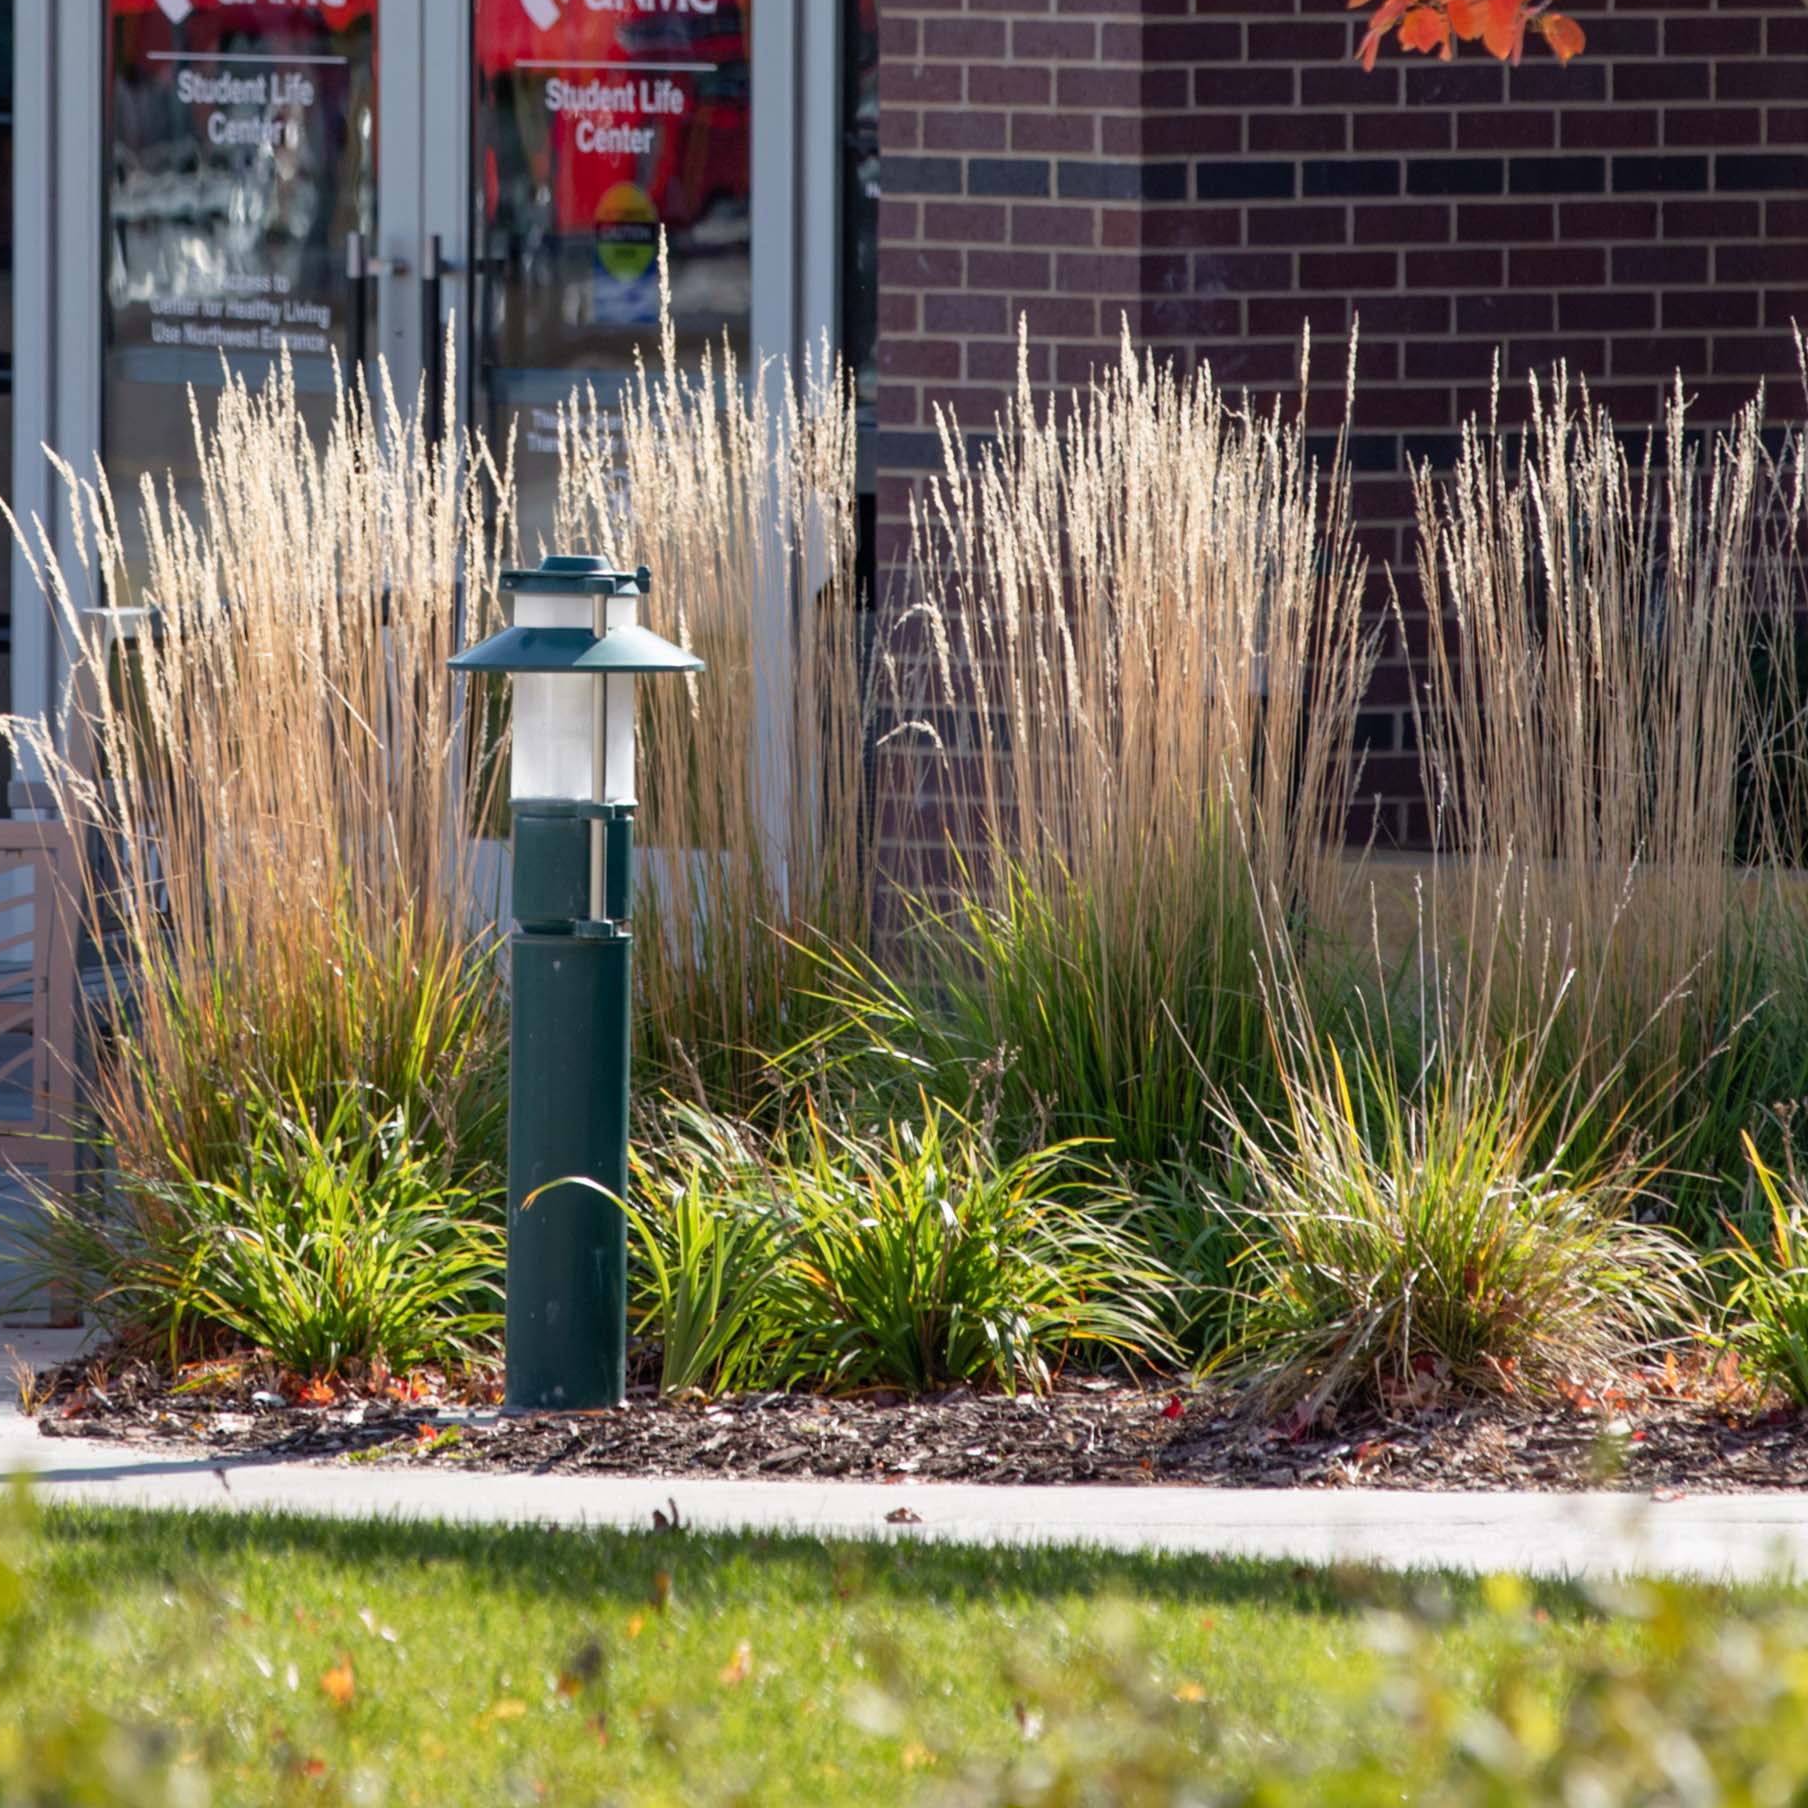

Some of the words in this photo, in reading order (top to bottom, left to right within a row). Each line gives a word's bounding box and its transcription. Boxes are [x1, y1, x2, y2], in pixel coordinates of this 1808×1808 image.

[177, 68, 266, 104] Student
[270, 72, 315, 106] Life
[544, 77, 636, 111] Student
[640, 79, 685, 115] Life
[207, 111, 283, 146] Center
[575, 120, 655, 153] Center
[225, 299, 282, 327] Healthy
[283, 300, 331, 330] Living
[151, 320, 182, 344] Use
[183, 320, 258, 348] Northwest
